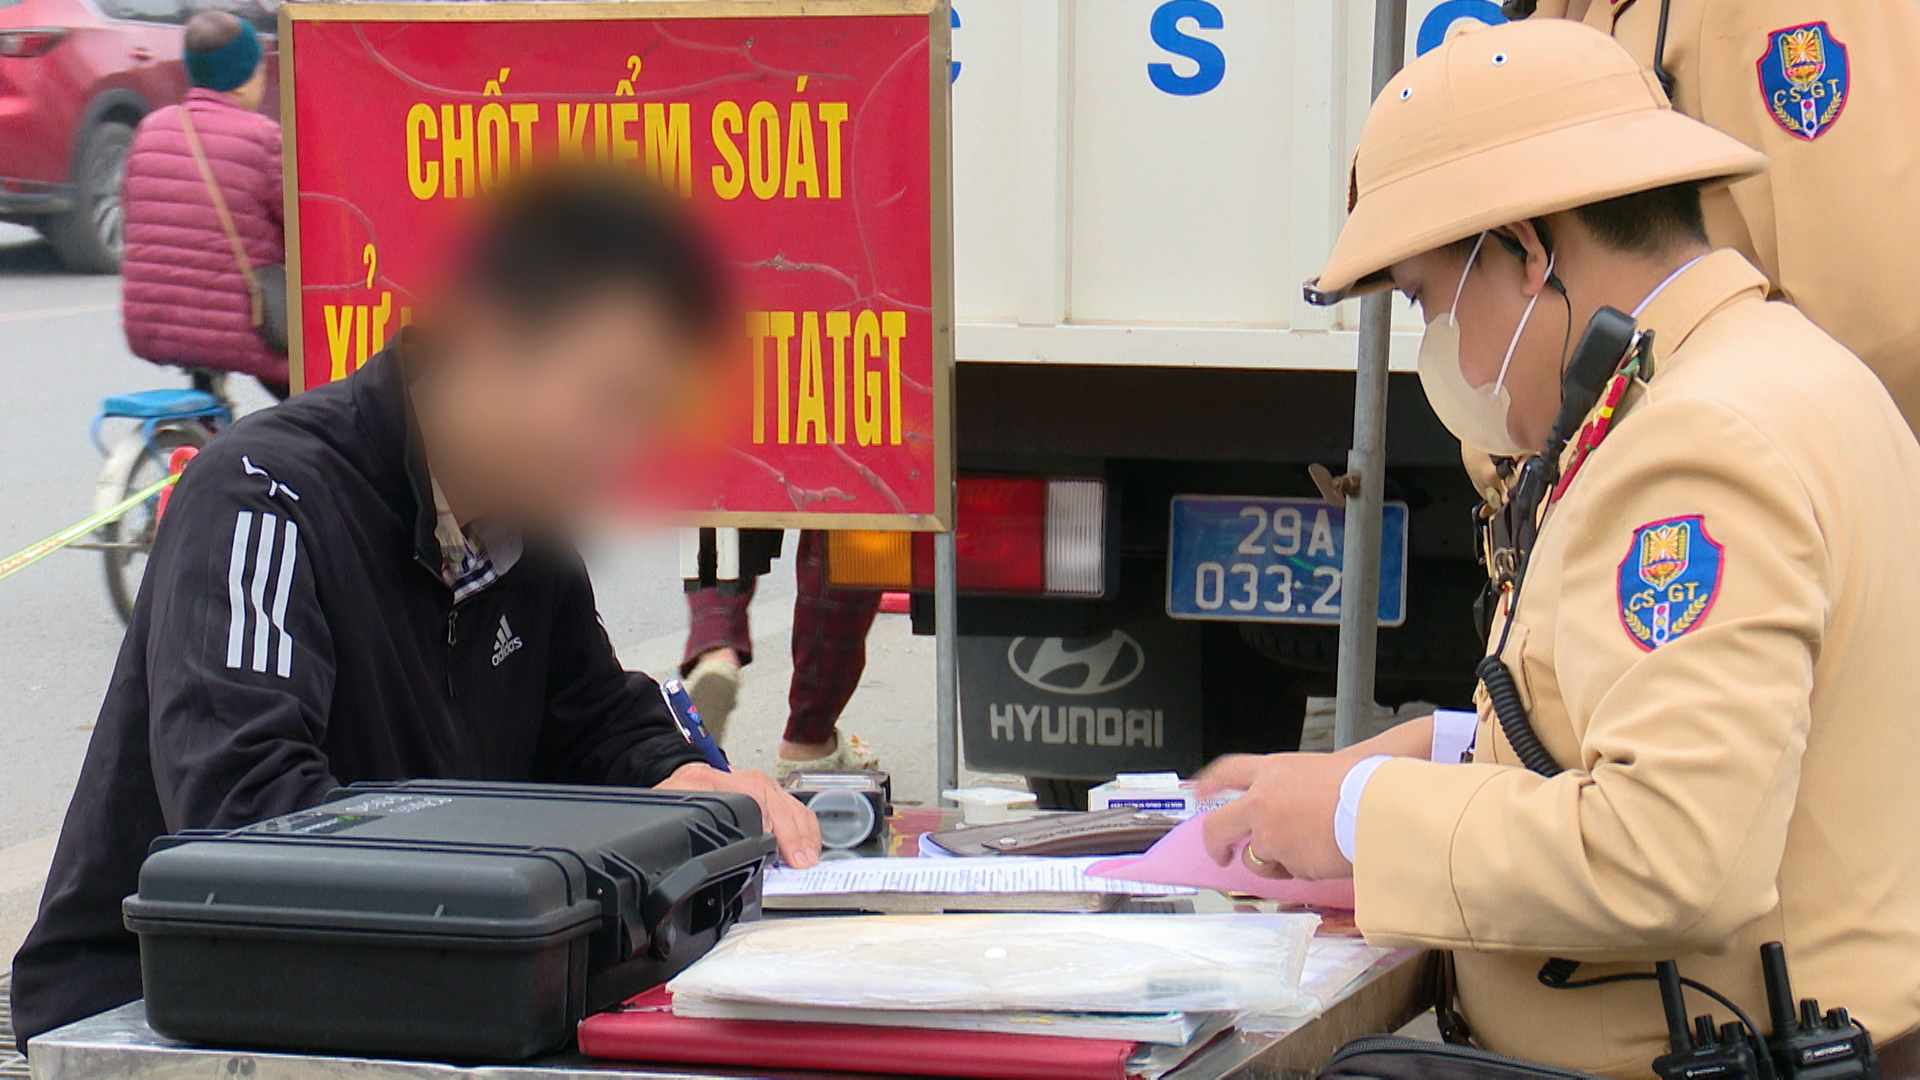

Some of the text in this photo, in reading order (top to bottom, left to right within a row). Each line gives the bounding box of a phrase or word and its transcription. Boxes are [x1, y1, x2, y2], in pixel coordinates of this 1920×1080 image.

[406, 67, 540, 200] CHỐT
[711, 75, 850, 201] SOÁT
[1237, 505, 1336, 558] 29A
[1195, 561, 1343, 615] 033.2
[989, 702, 1165, 750] HYUNDAI
